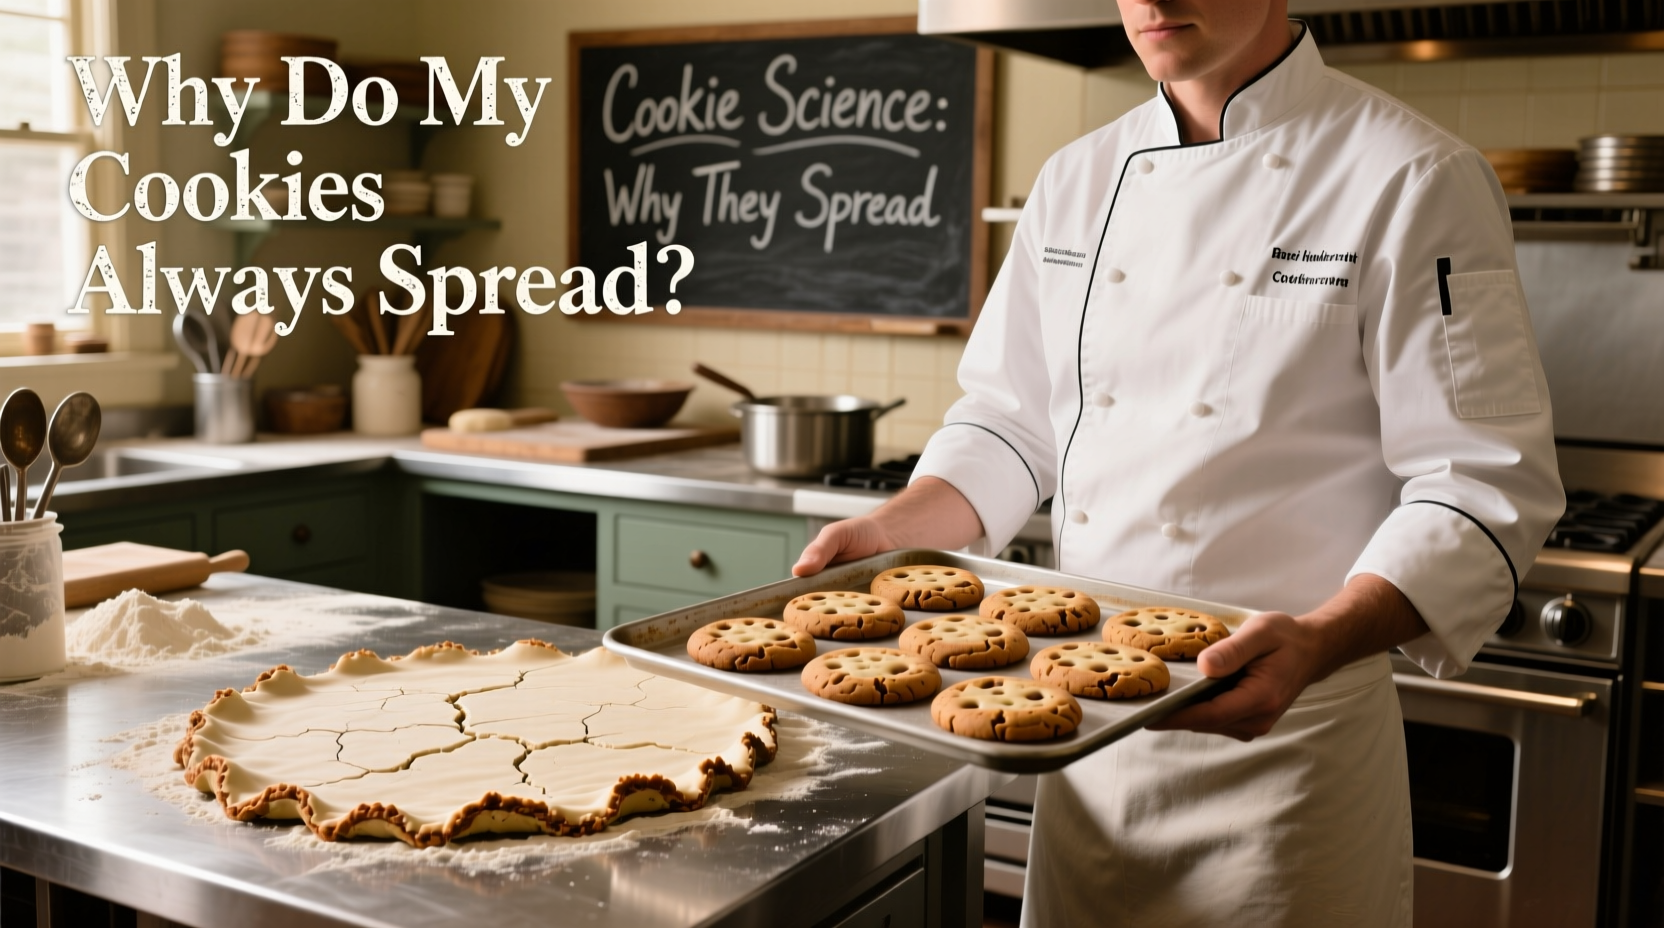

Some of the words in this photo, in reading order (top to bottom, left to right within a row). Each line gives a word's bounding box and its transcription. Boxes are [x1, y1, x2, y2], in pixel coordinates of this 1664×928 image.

[602, 63, 744, 143] Cookie
[758, 54, 949, 135] Science:
[604, 163, 682, 244] Why
[692, 160, 781, 249] They
[795, 163, 941, 253] Spread
